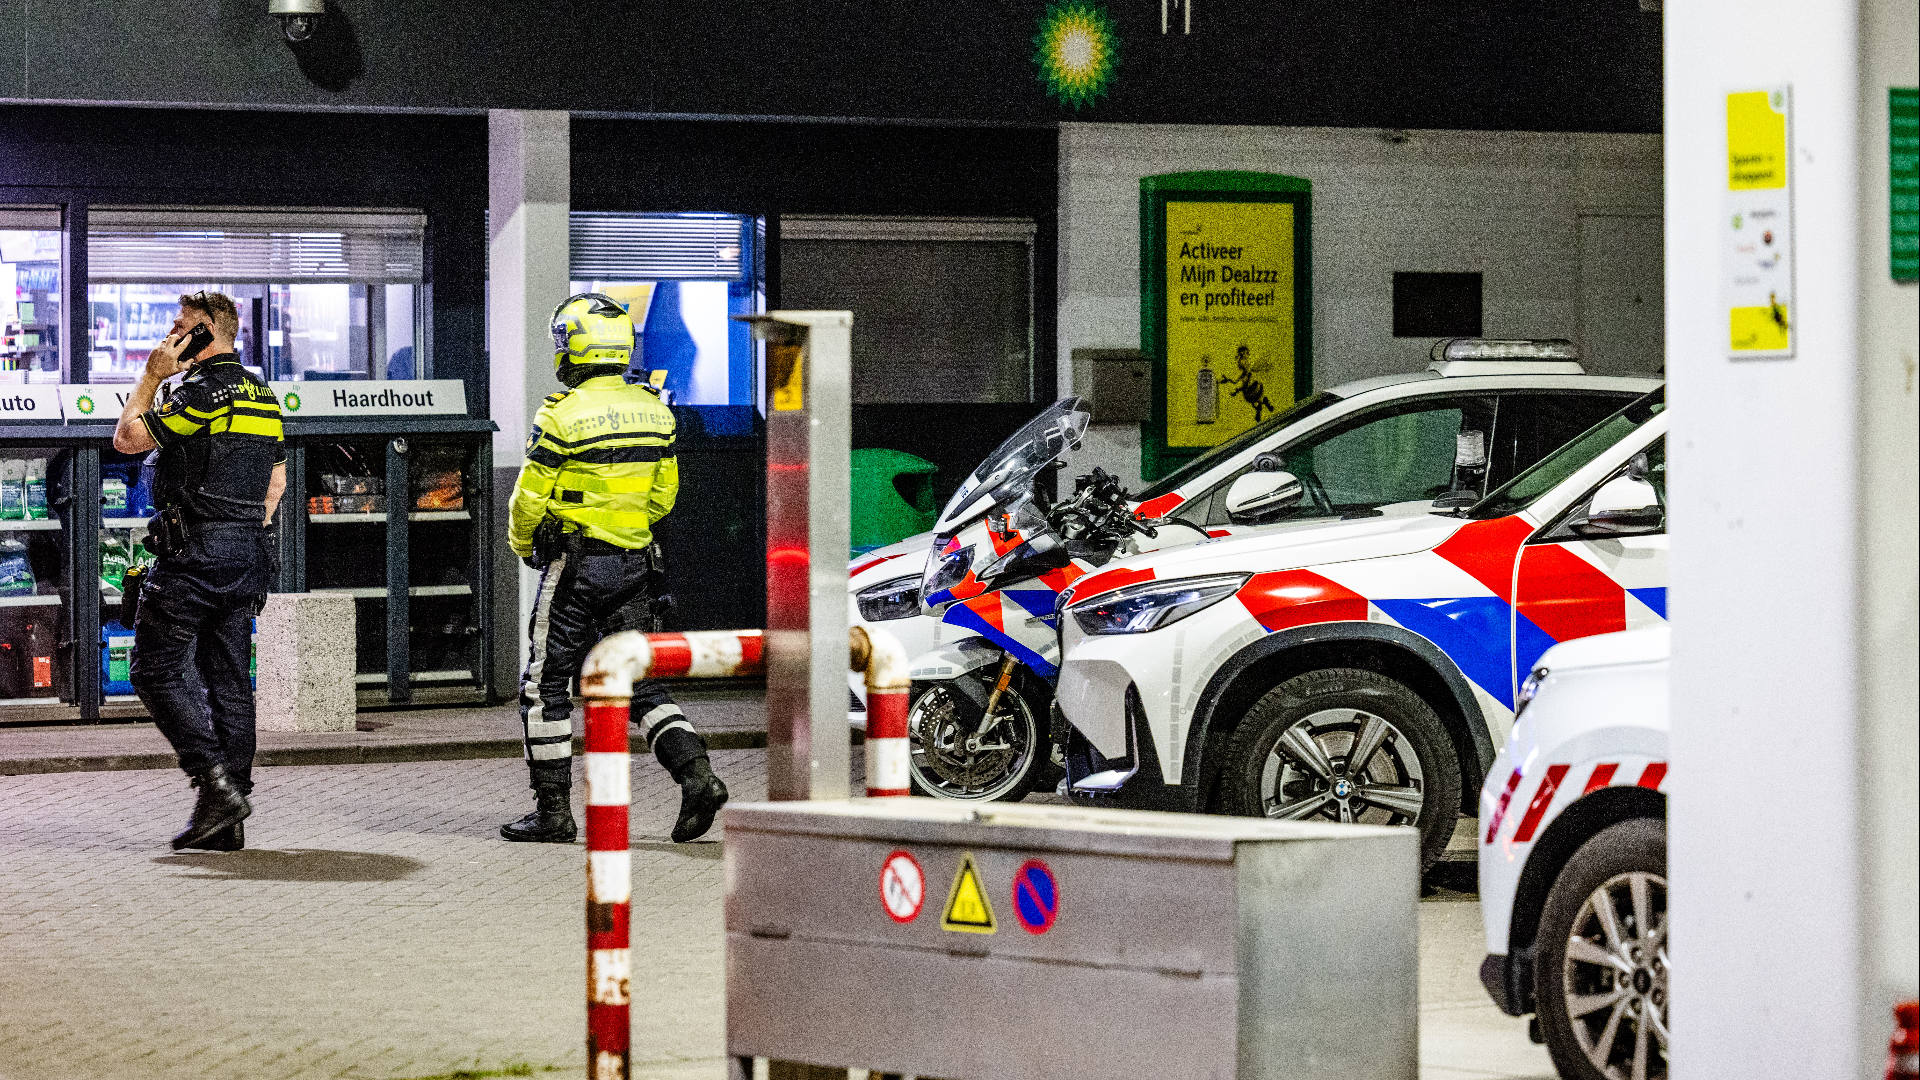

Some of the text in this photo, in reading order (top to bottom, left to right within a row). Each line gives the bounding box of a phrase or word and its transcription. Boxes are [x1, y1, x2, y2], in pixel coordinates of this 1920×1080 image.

[1180, 242, 1243, 259] Activeer
[1181, 265, 1278, 288] Mijn Dealzzz
[1181, 287, 1274, 310] en profiteer!
[0, 395, 36, 411] uto
[333, 389, 434, 408] Haardhout
